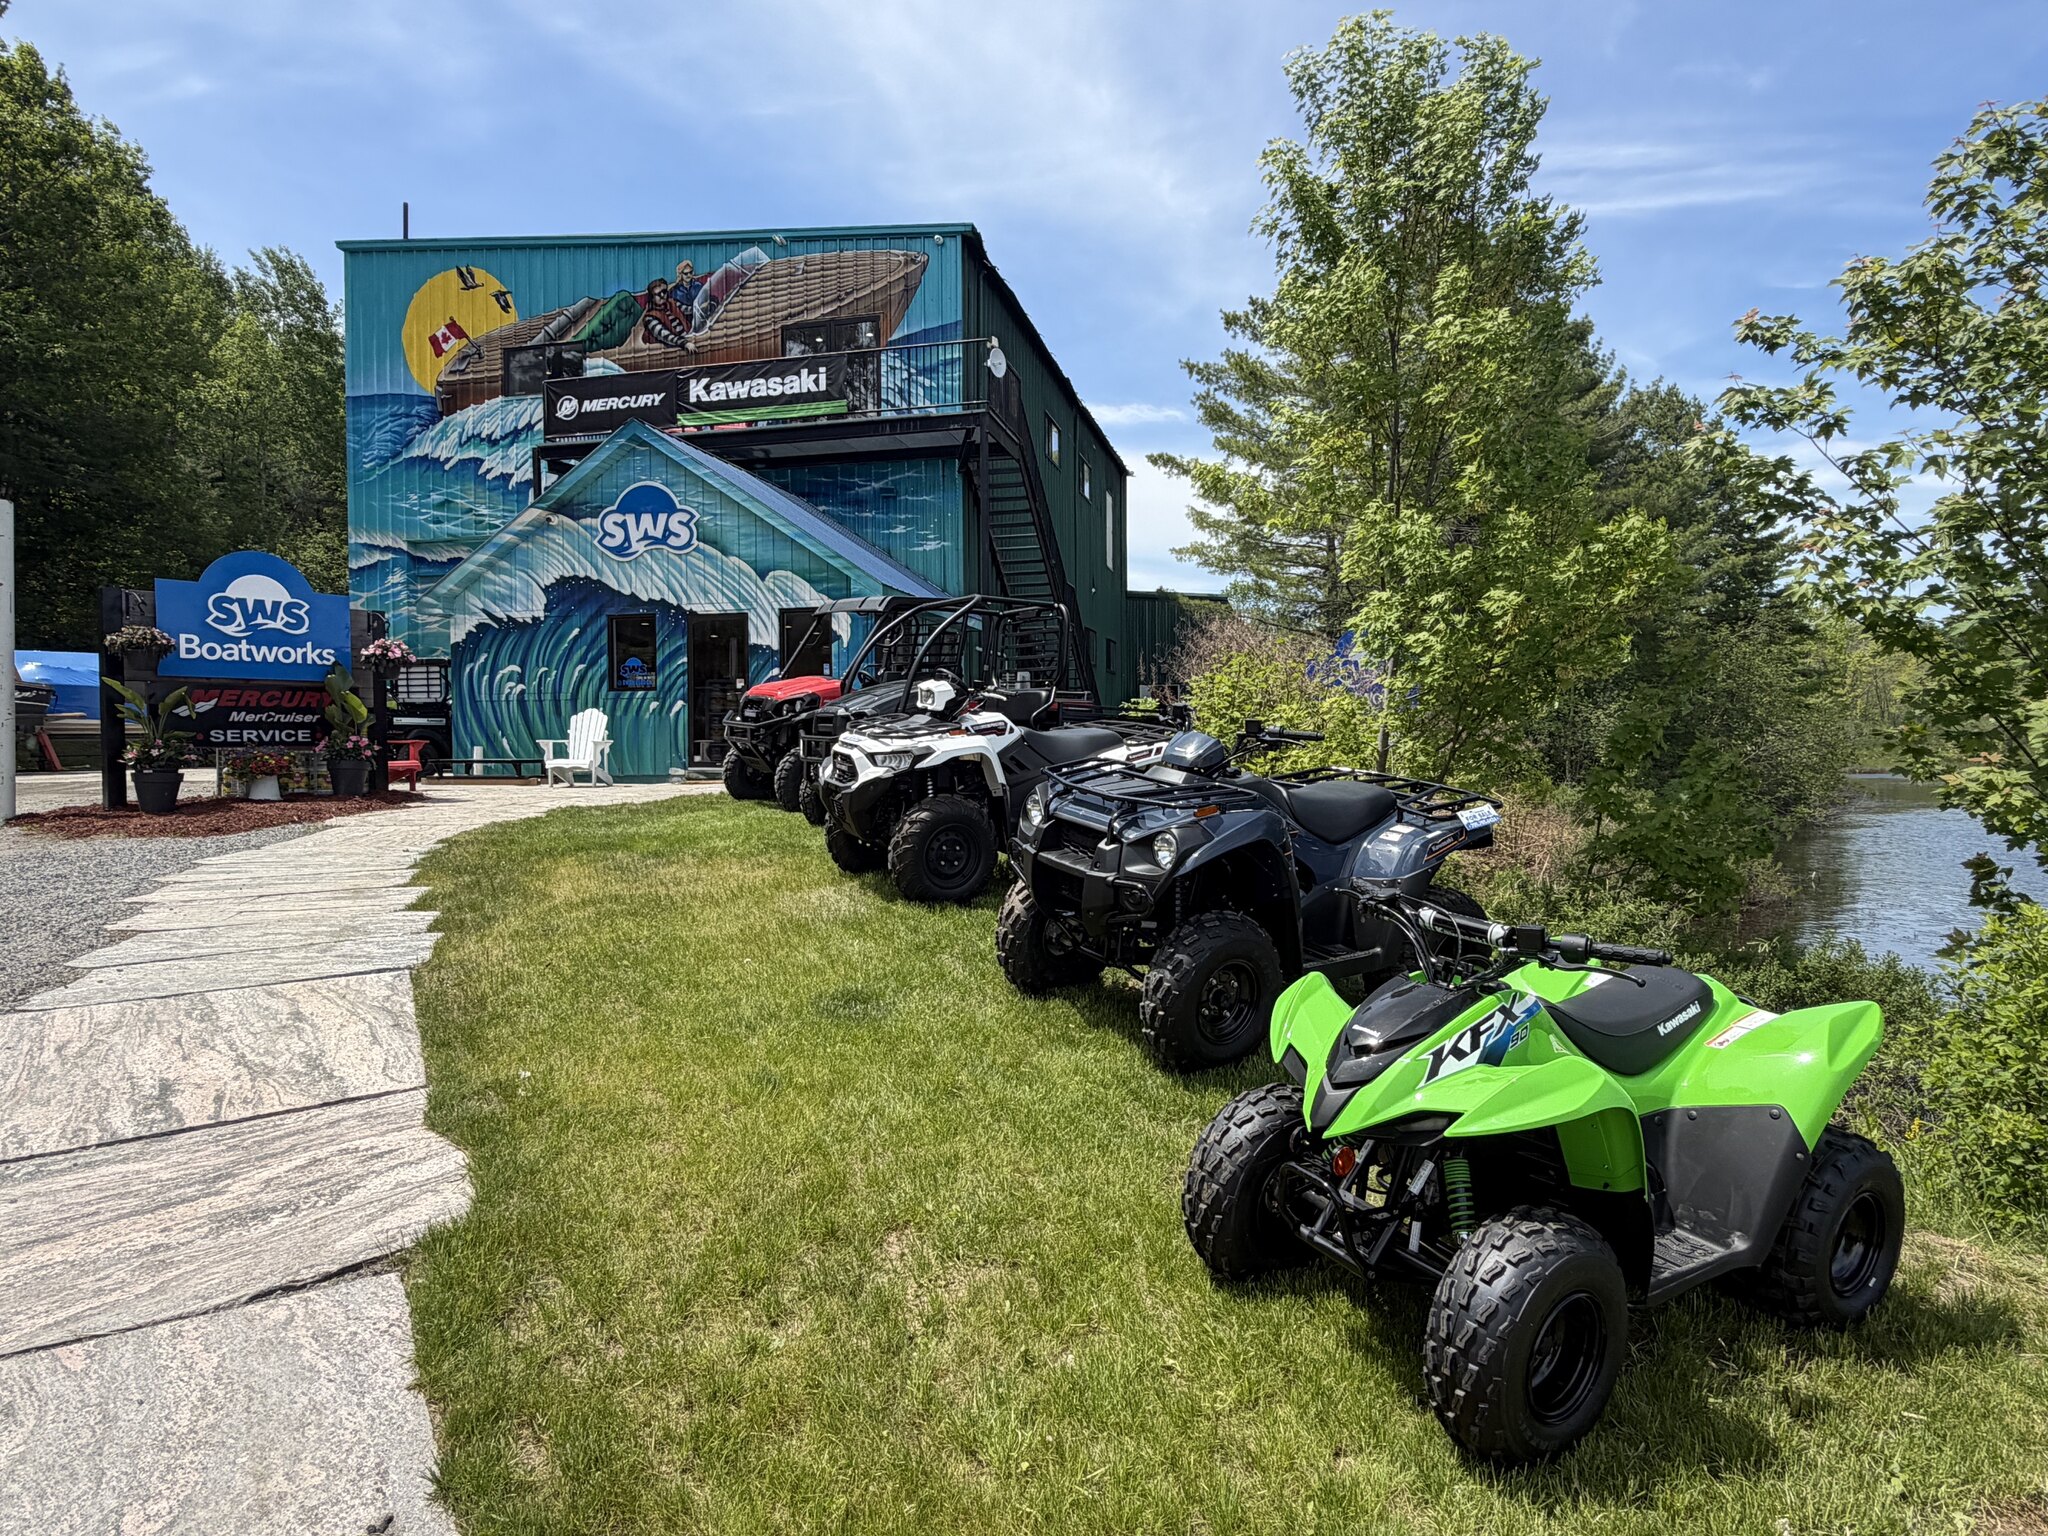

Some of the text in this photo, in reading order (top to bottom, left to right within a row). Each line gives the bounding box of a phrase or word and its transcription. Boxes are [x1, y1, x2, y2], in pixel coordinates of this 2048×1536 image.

[689, 366, 828, 403] Kawasaki
[581, 393, 667, 414] MERCURY
[601, 511, 693, 551] SWS
[209, 595, 309, 633] SWS
[179, 633, 336, 666] Boatworks
[228, 711, 321, 723] MerCruiser
[209, 729, 312, 743] SERVICE
[1656, 1000, 1702, 1037] Kawasaki
[1424, 991, 1521, 1083] KFX
[1508, 1024, 1529, 1050] 90
